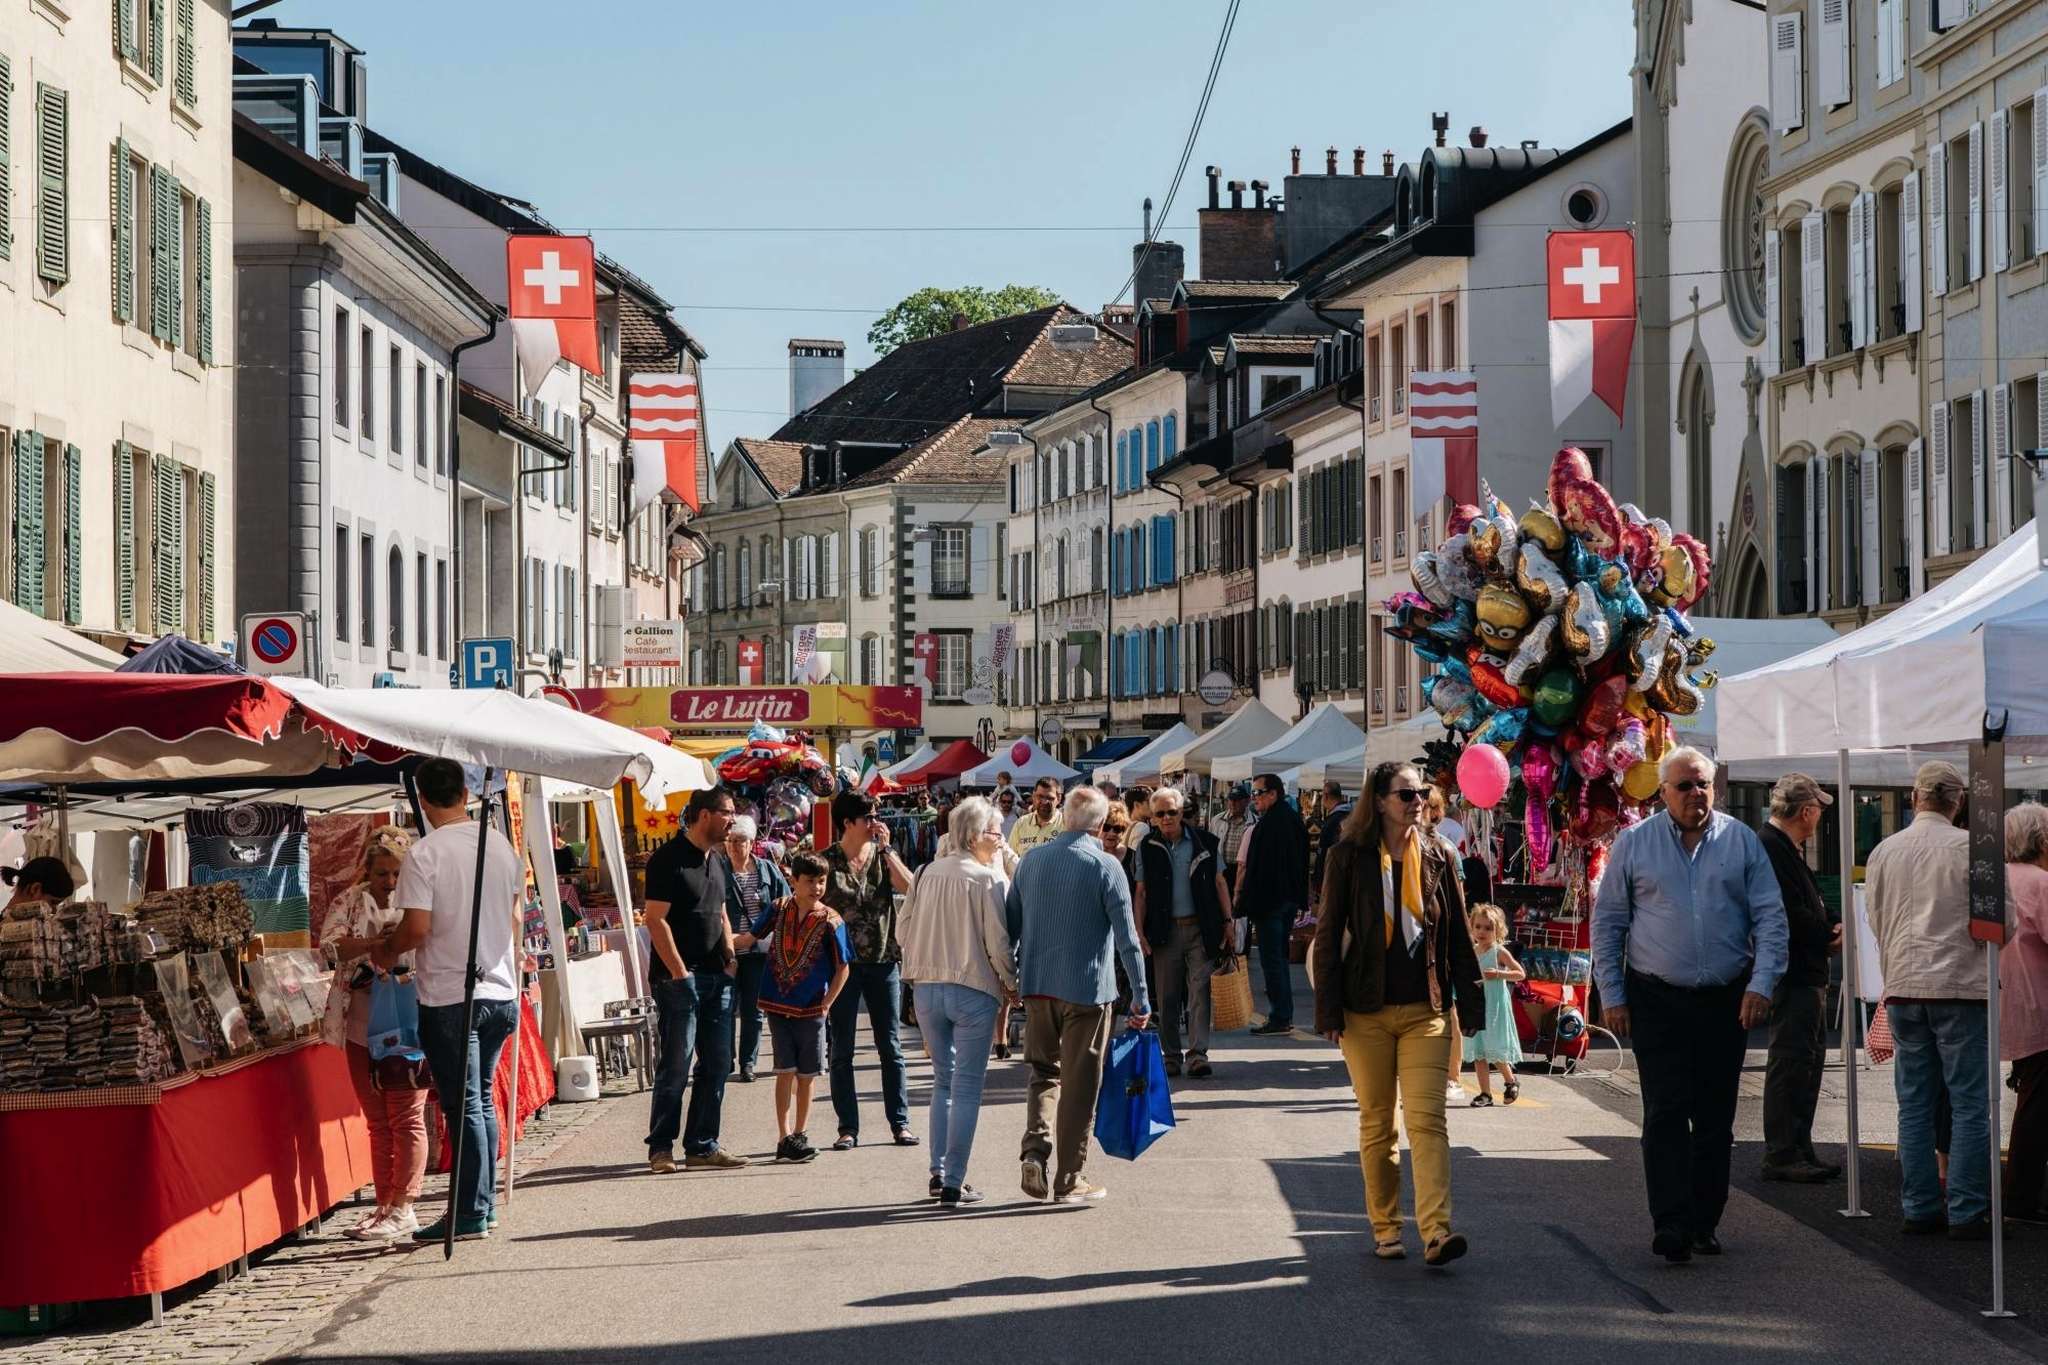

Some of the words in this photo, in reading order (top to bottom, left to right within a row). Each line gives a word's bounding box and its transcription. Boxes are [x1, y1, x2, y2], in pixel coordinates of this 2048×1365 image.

[634, 626, 673, 635] Gallion
[474, 646, 497, 681] P
[687, 695, 719, 720] Le
[722, 694, 793, 719] Lutin
